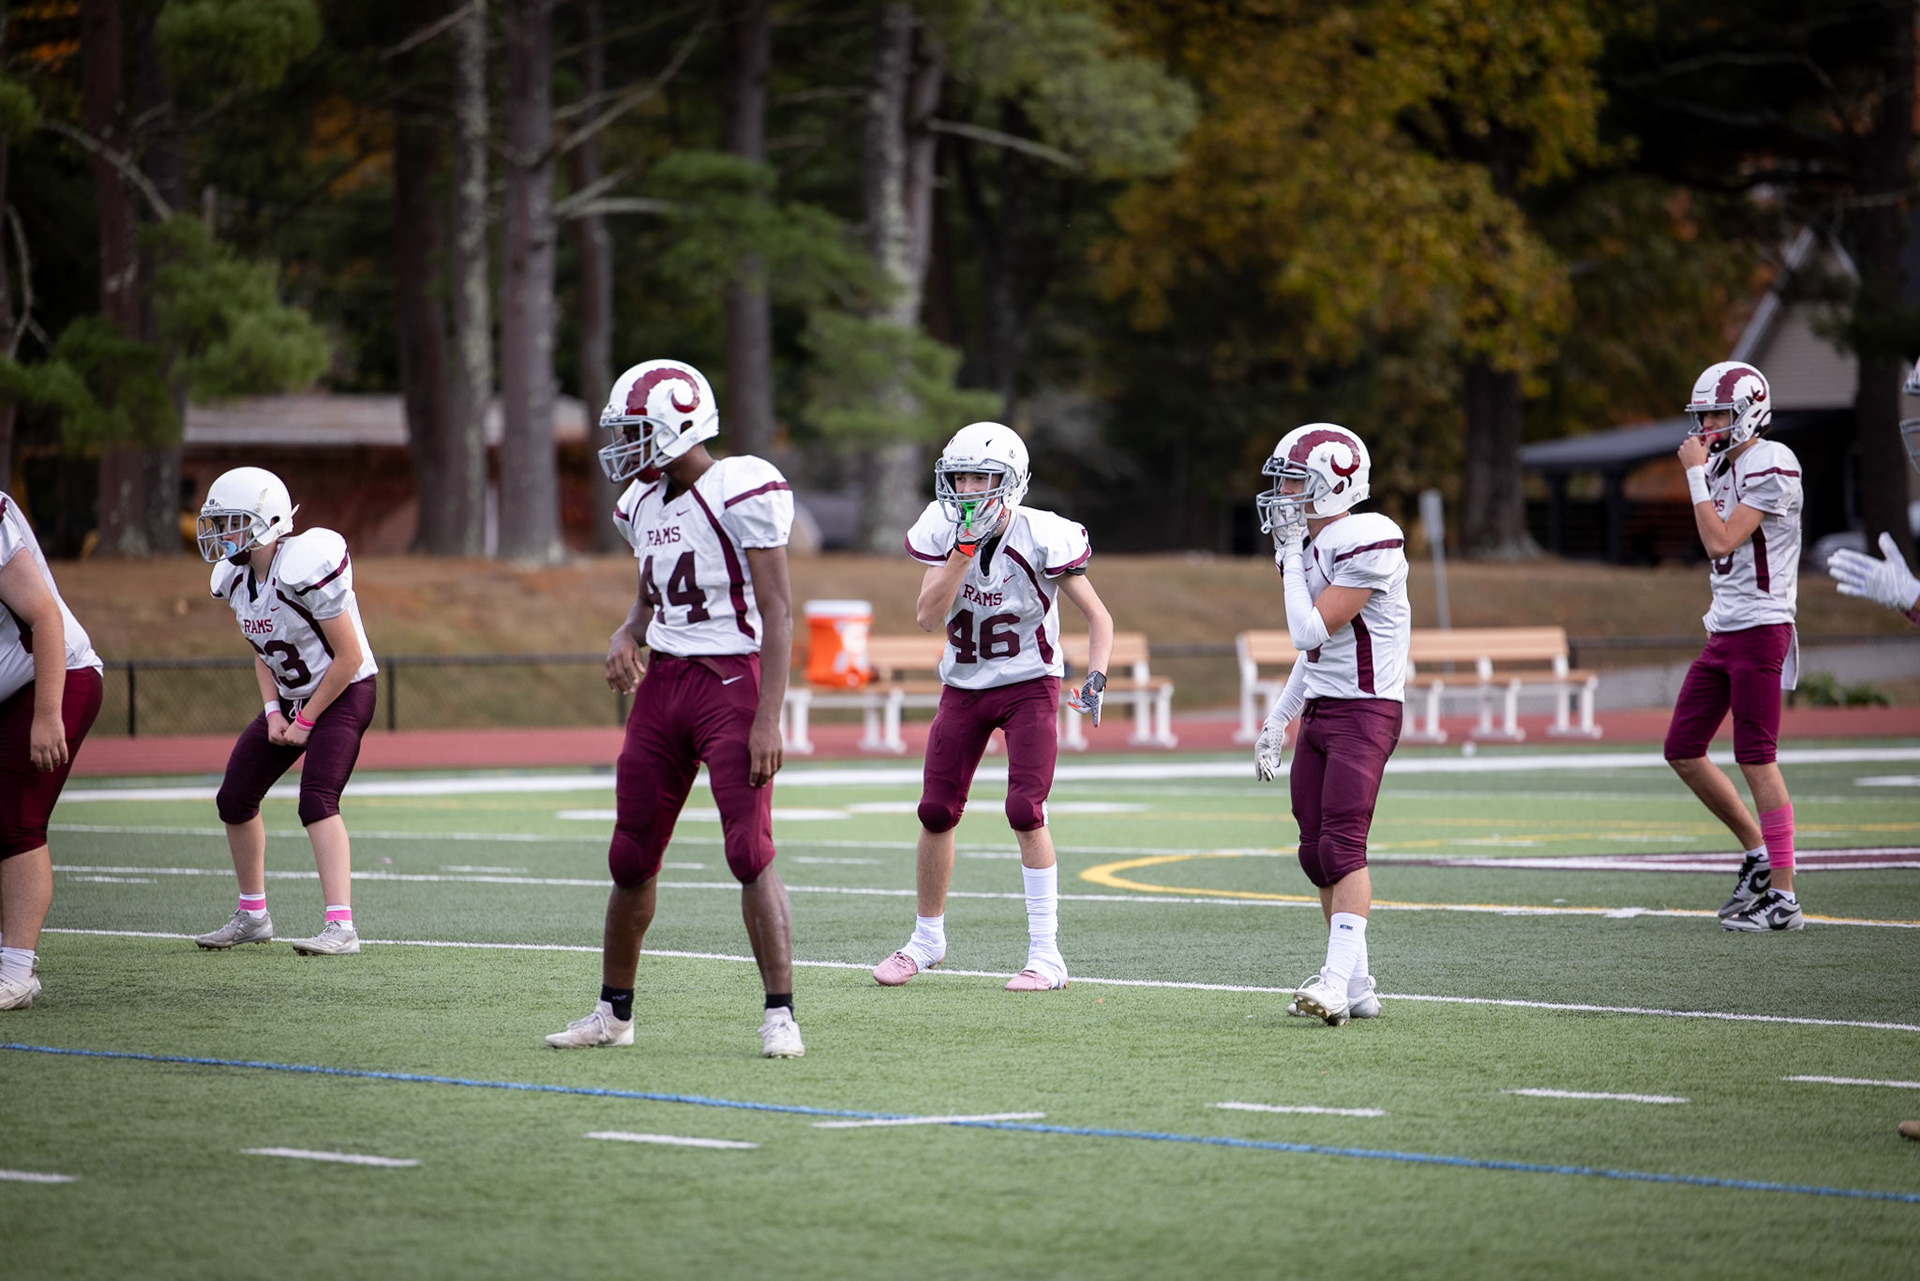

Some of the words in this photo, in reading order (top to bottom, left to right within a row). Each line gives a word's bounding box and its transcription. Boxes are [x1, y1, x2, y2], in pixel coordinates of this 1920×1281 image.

[641, 550, 711, 624] 44
[962, 583, 1003, 607] RAMS
[243, 618, 274, 634] RAMS
[946, 608, 1021, 664] 46
